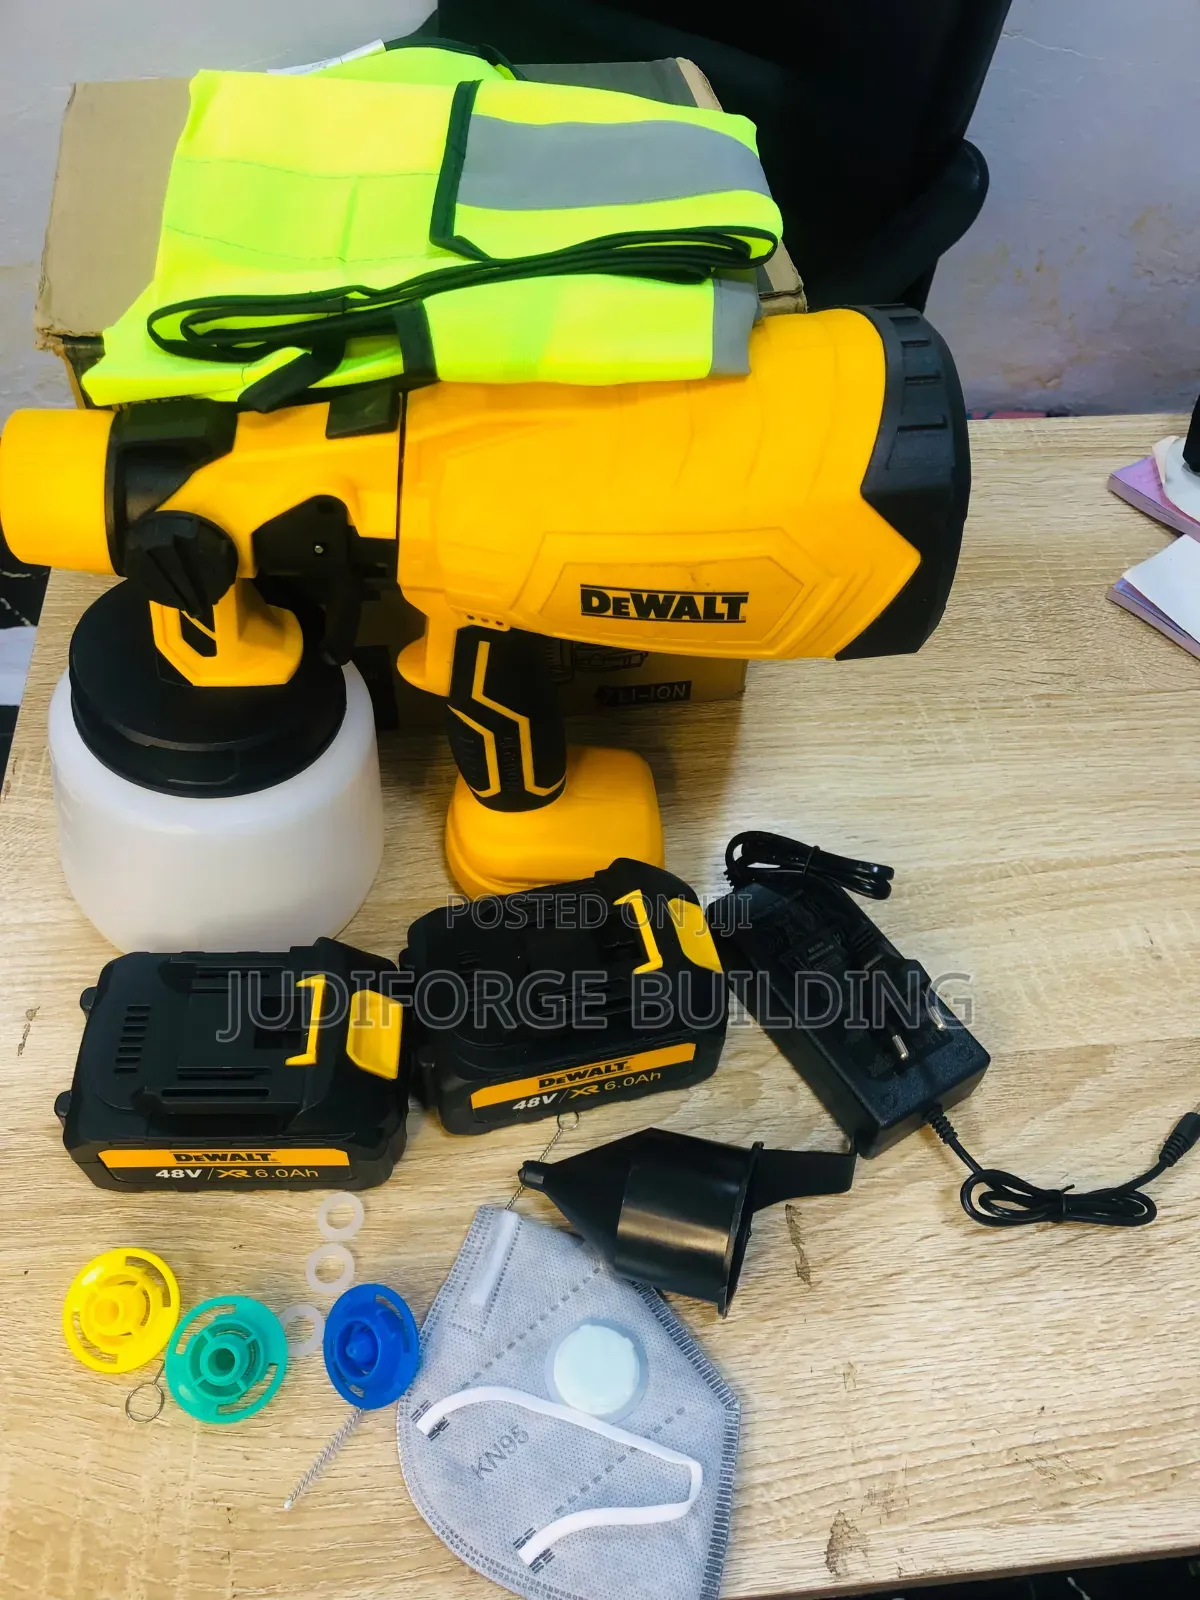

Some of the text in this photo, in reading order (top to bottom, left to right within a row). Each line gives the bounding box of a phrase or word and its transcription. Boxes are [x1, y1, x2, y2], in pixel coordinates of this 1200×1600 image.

[604, 1071, 662, 1091] 6.0Ah
[255, 1168, 319, 1179] 6.0Ah
[470, 1424, 530, 1481] KN95
